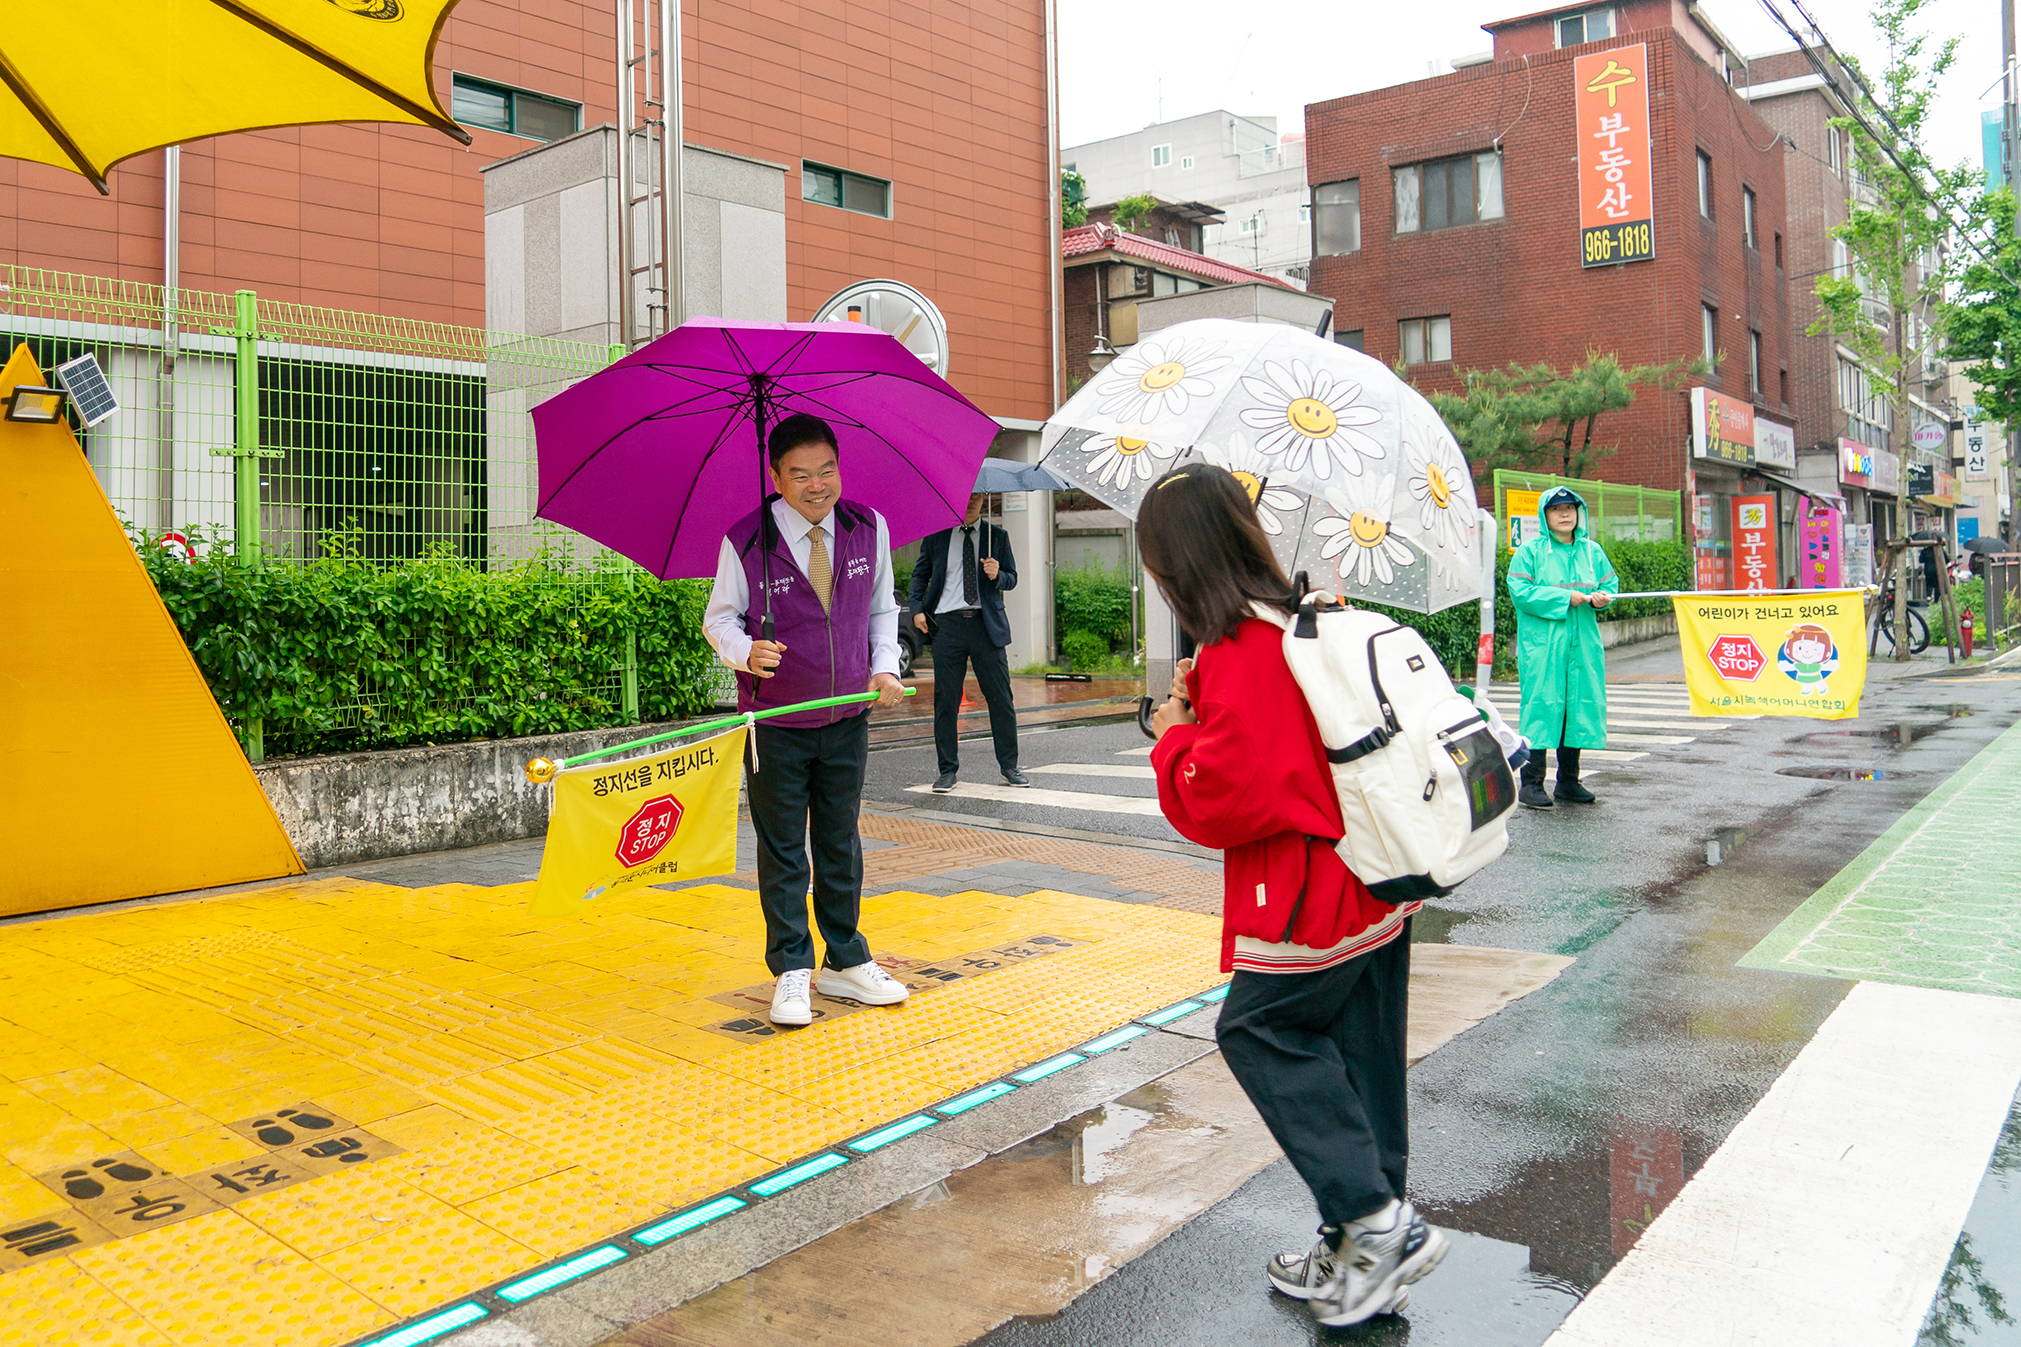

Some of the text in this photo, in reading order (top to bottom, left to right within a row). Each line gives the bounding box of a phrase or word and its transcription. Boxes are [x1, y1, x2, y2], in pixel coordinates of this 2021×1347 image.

[1586, 60, 1637, 219] 수 부동산
[1585, 223, 1650, 263] 966-1818
[1721, 440, 1748, 463] 966-1818
[1698, 604, 1840, 620] 어린이가 건너고 있어요
[1721, 641, 1752, 657] 정지
[1718, 657, 1760, 671] STOP
[592, 746, 719, 797] 정지선을 지킵시다.
[630, 831, 666, 855] STOP
